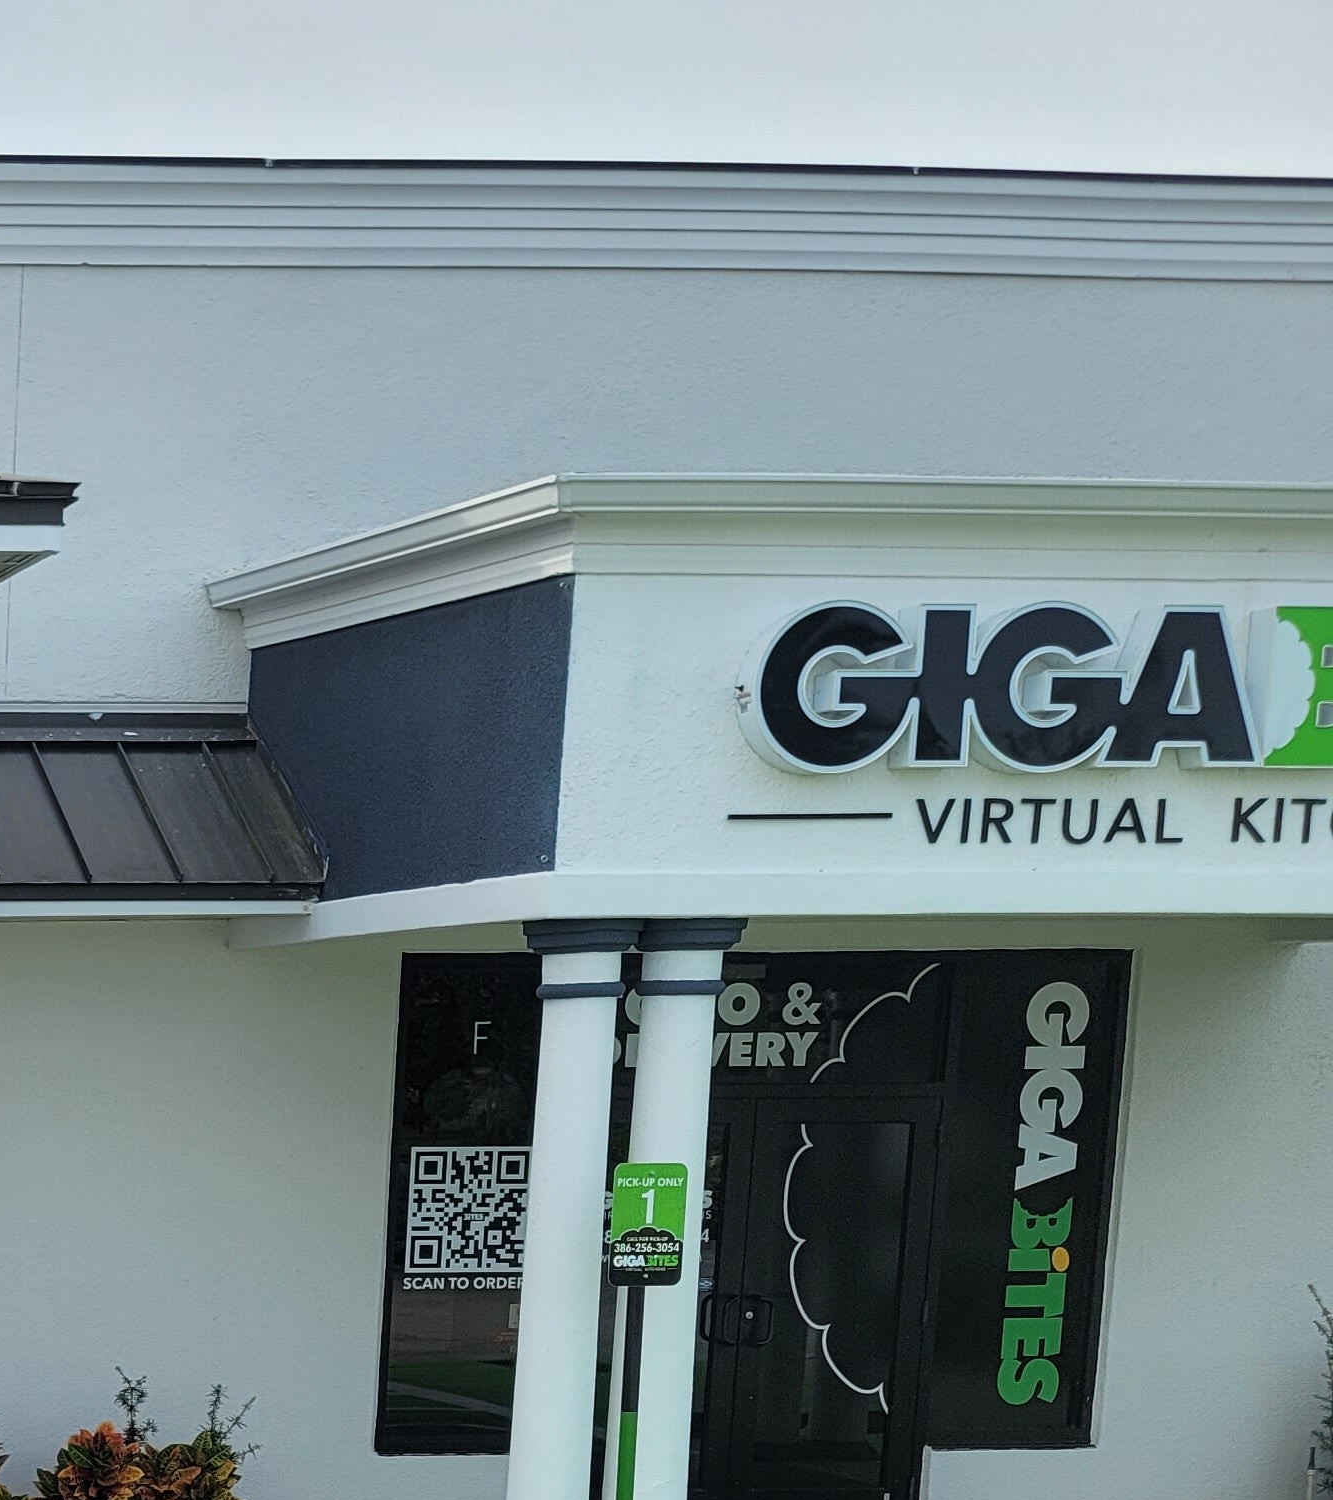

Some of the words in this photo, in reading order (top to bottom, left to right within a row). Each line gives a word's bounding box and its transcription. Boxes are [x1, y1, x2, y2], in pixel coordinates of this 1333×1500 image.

[755, 599, 1261, 774] GIGA
[916, 798, 1183, 844] VIRTUAL
[1231, 797, 1333, 844] KIT
[782, 982, 822, 1025] &
[473, 1021, 492, 1054] F
[1014, 981, 1090, 1190] GIGA
[617, 1177, 655, 1187] PICK-UP
[657, 1177, 684, 1187] ONLY
[641, 1189, 655, 1224] 1
[613, 1254, 645, 1267] GIGA
[614, 1243, 680, 1253] 386-256-3054
[402, 1277, 445, 1289] SCAN
[447, 1277, 469, 1289] TO
